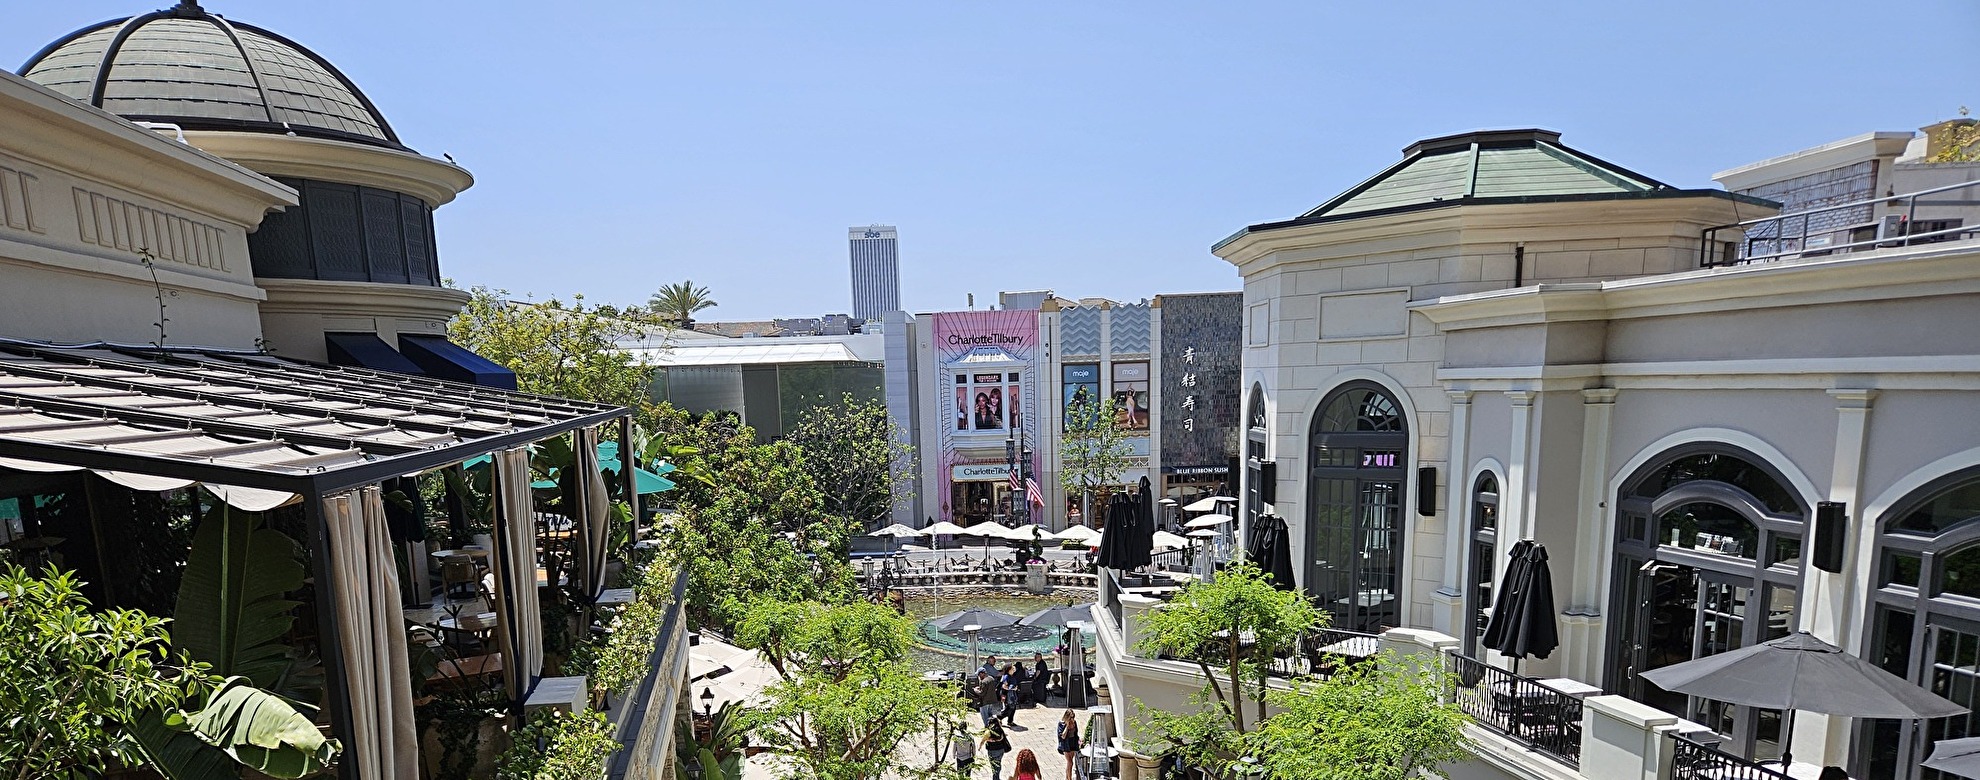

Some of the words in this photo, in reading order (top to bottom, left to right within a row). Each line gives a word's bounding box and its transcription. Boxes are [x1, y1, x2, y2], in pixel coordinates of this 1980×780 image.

[864, 228, 881, 239] sbe
[1072, 370, 1089, 378] maje
[1122, 367, 1139, 376] maje
